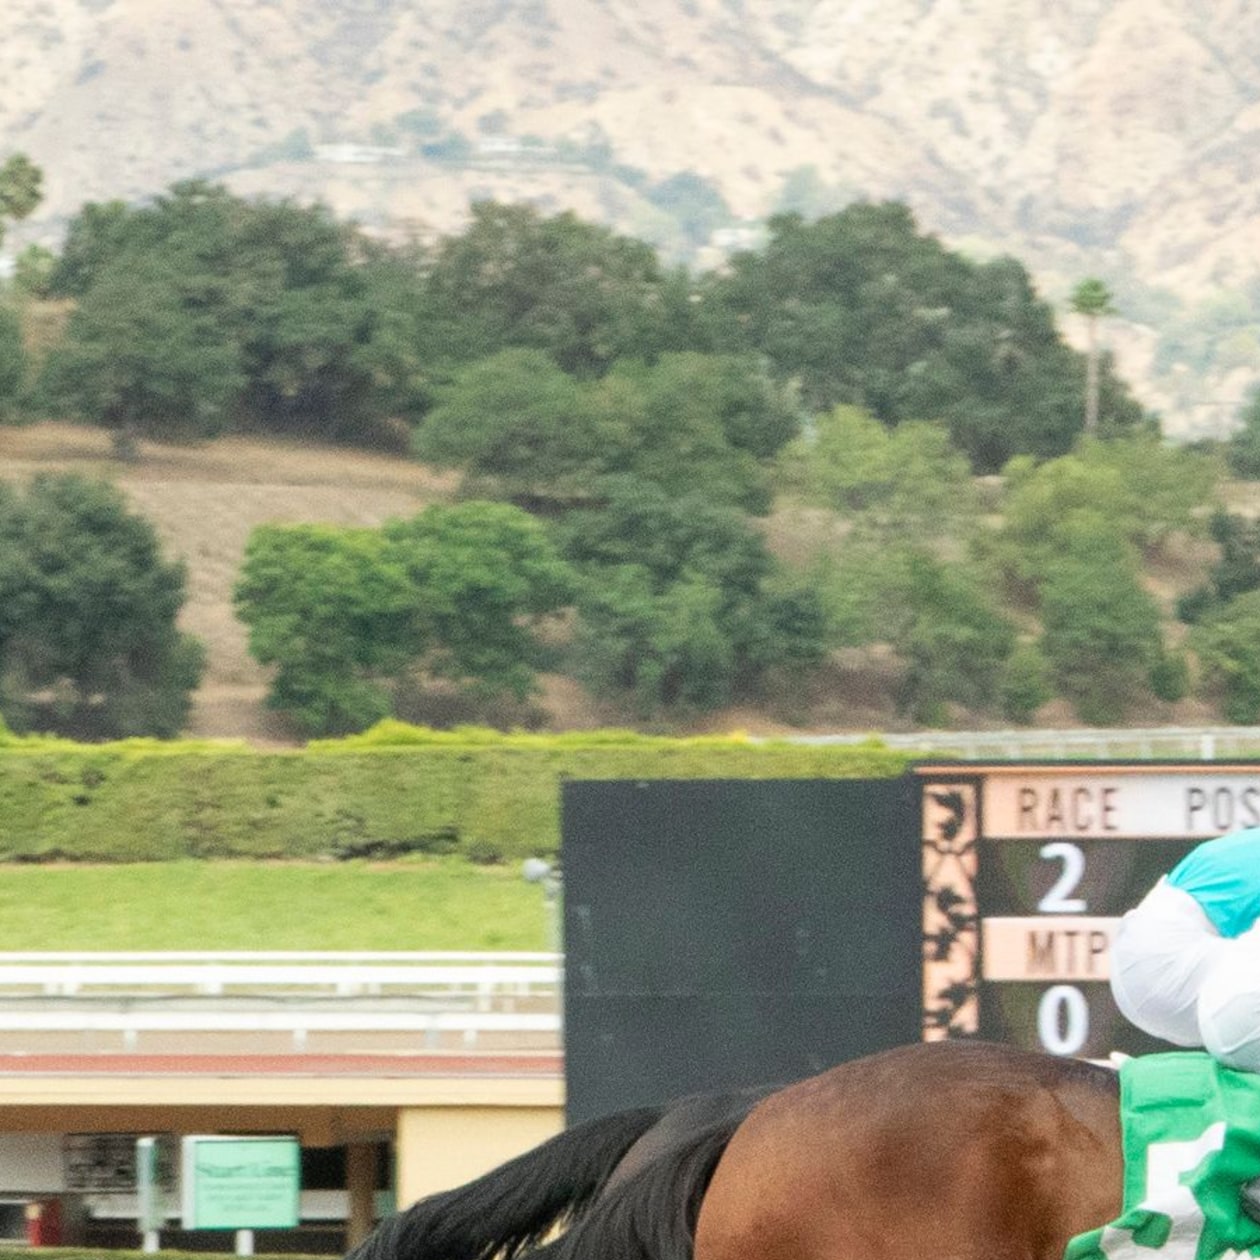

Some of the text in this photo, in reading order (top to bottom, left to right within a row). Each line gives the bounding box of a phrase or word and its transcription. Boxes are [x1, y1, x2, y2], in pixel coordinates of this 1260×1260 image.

[1017, 786, 1121, 832] RACE
[1037, 842, 1088, 914] 2
[1026, 931, 1107, 974] MTP
[1036, 984, 1090, 1056] 0
